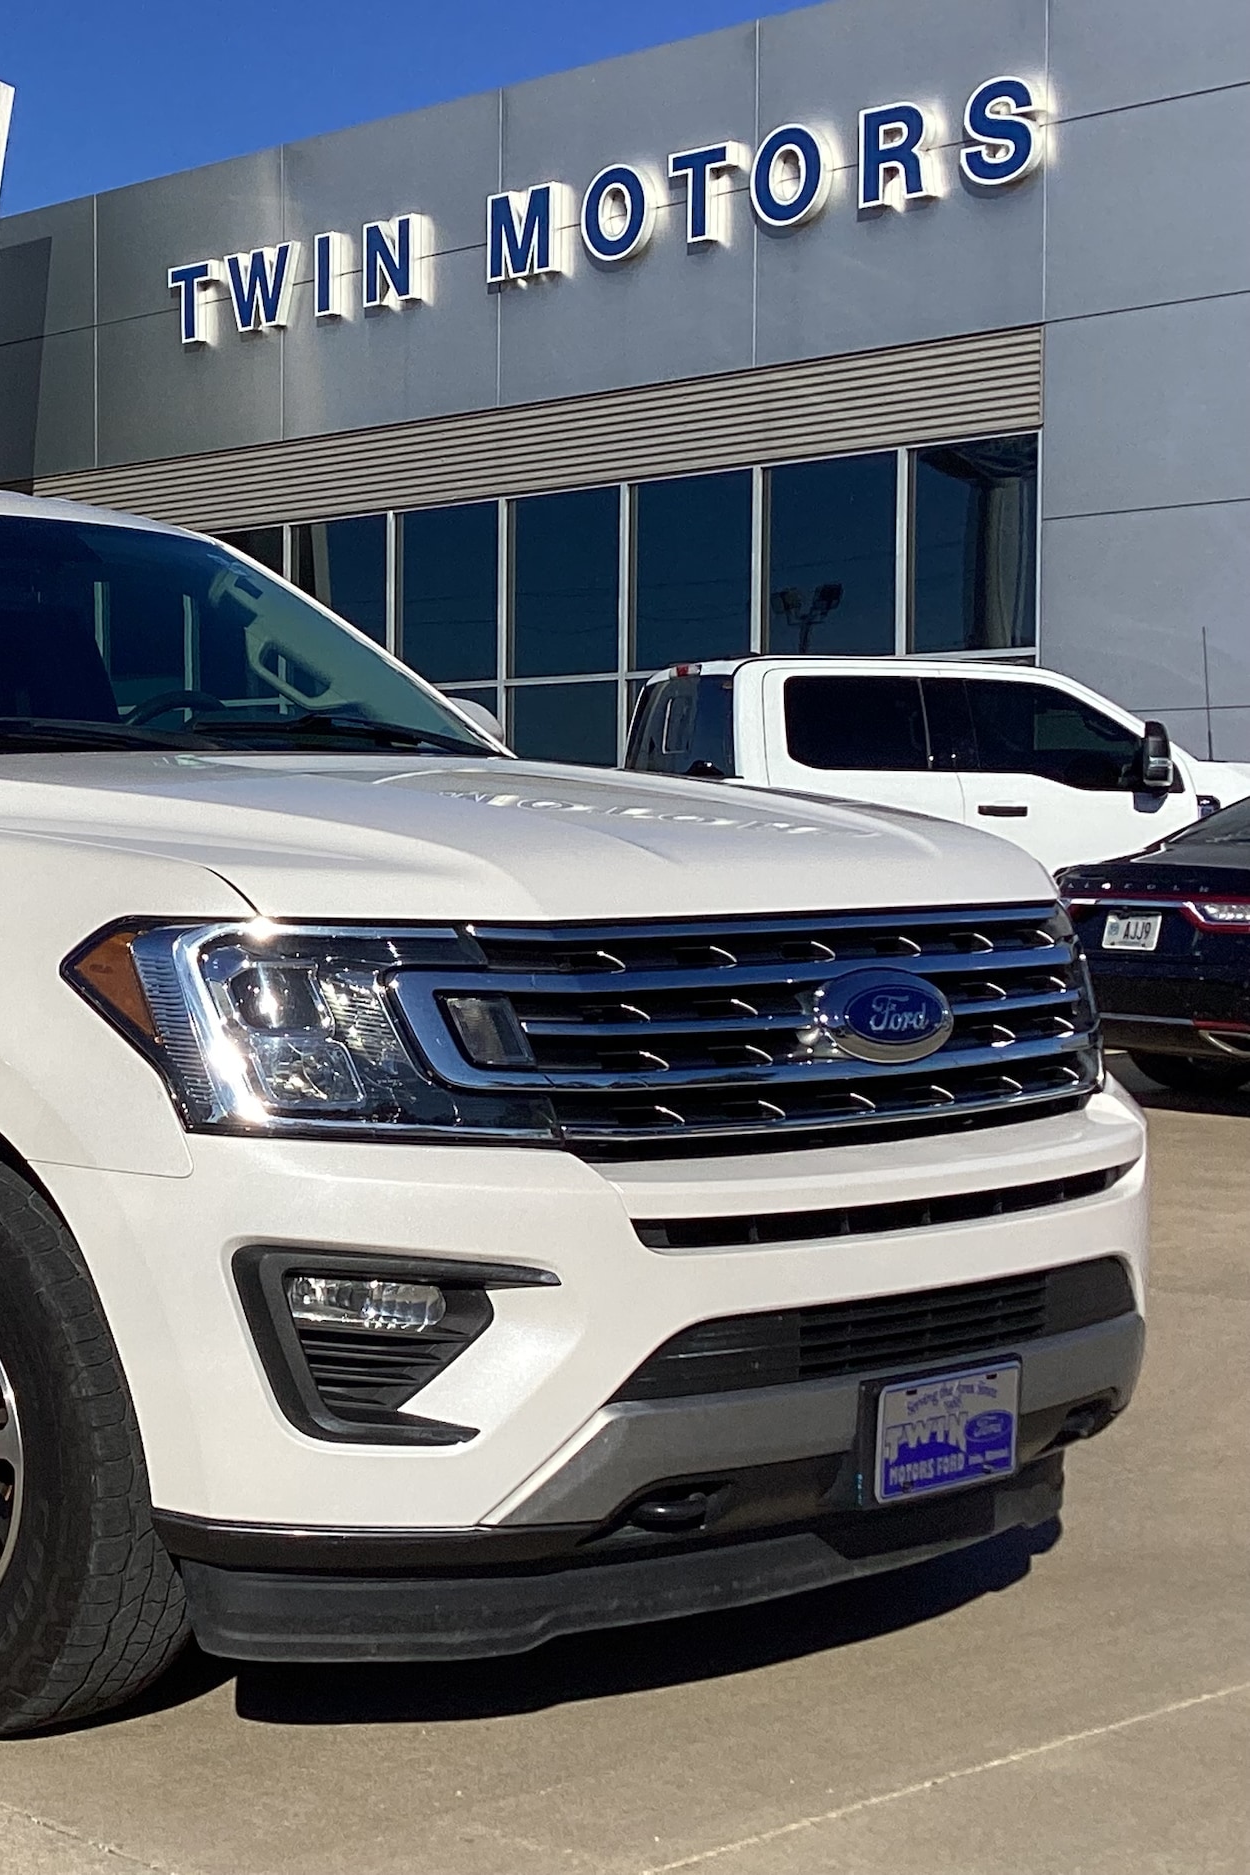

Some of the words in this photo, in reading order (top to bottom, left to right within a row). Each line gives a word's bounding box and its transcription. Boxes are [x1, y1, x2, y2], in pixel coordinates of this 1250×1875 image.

[168, 211, 426, 345] TWIN
[487, 75, 1050, 284] MOTORS
[869, 995, 930, 1032] Ford
[885, 1411, 969, 1464] TWIN
[889, 1458, 934, 1487] MOTORS
[936, 1453, 965, 1477] FORD
